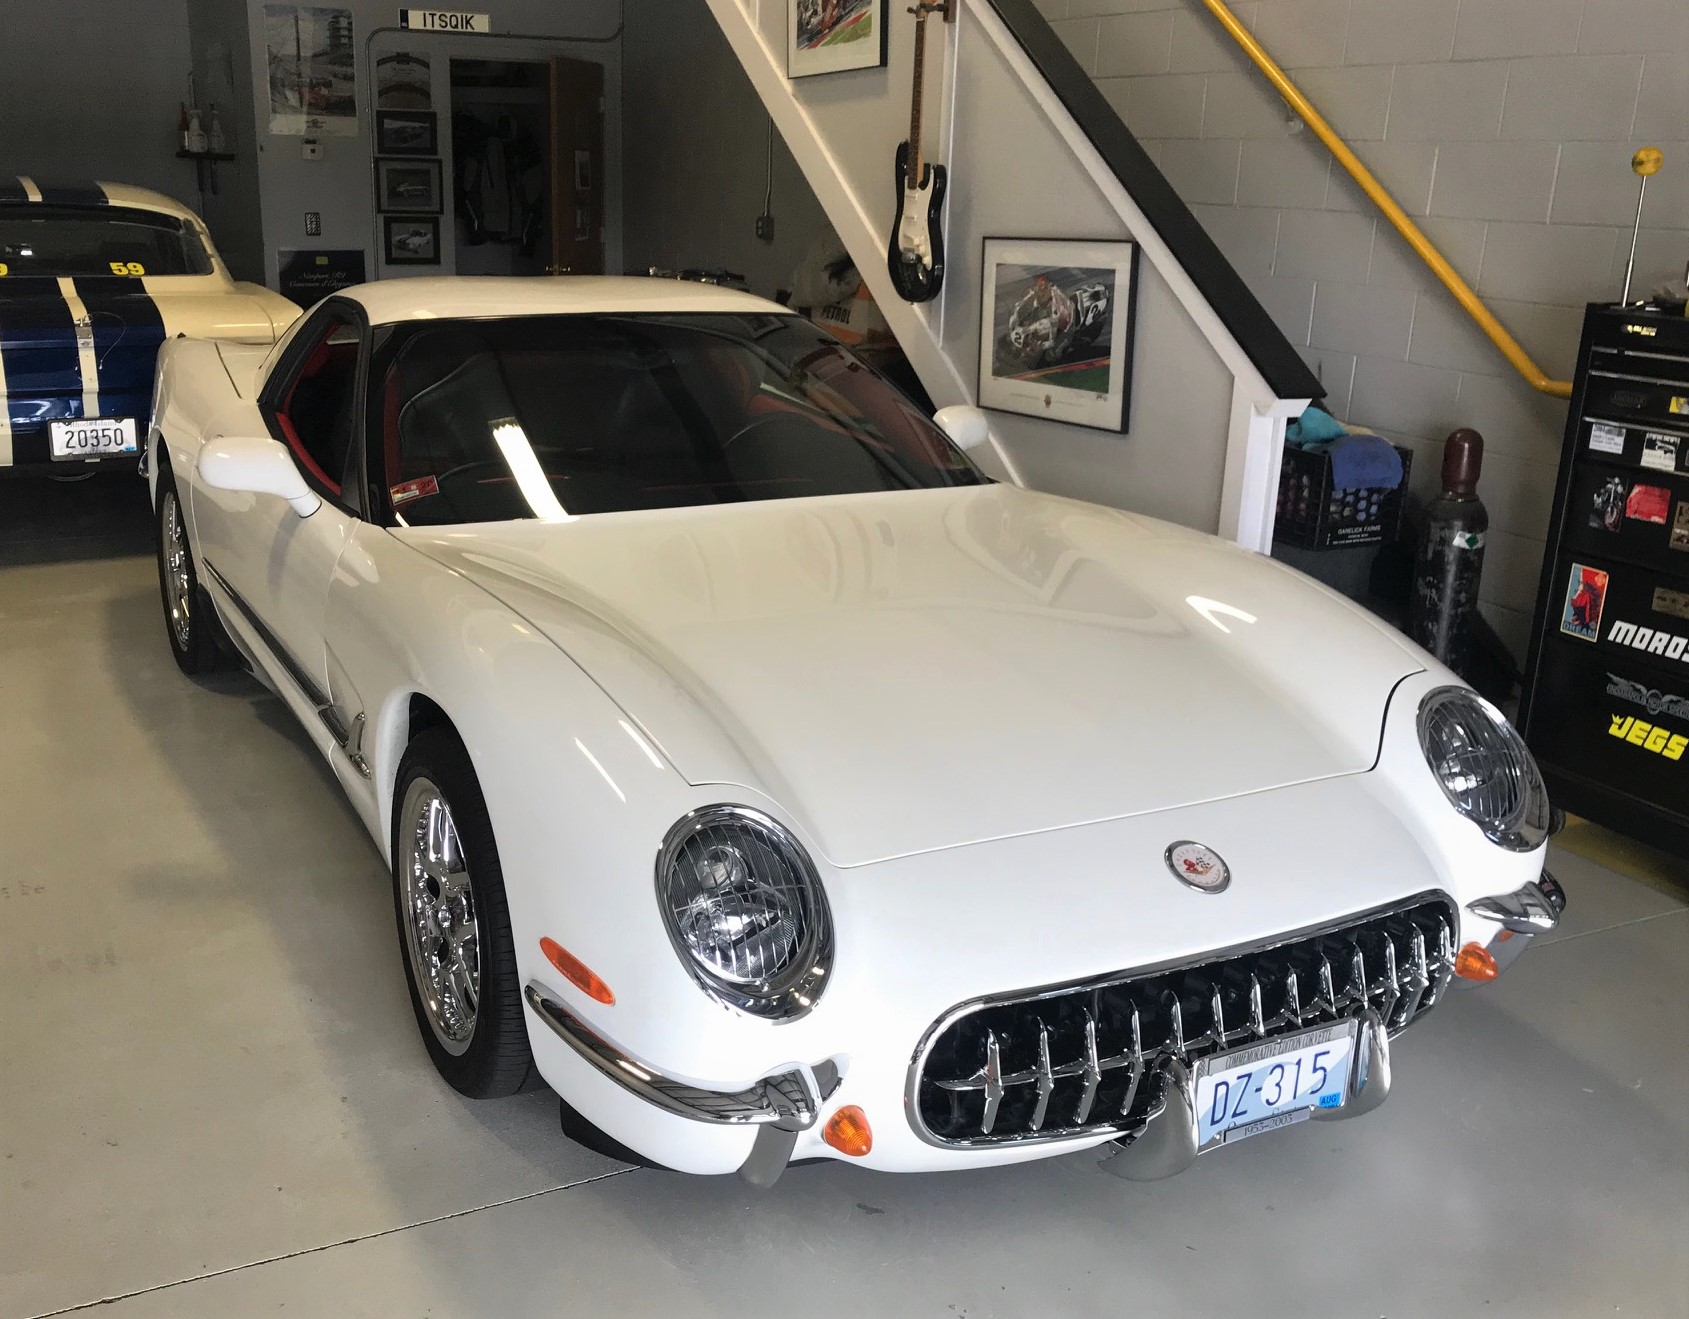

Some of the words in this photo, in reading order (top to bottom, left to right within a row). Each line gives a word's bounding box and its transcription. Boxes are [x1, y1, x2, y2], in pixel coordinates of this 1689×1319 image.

[423, 12, 475, 31] ITSQIK
[109, 262, 145, 276] 59
[822, 304, 851, 325] PETROL
[65, 427, 124, 449] 20350
[1563, 621, 1596, 639] DREAM
[1608, 715, 1689, 761] JEGS
[1210, 1050, 1331, 1127] DZ-315
[1320, 1094, 1337, 1106] AUG
